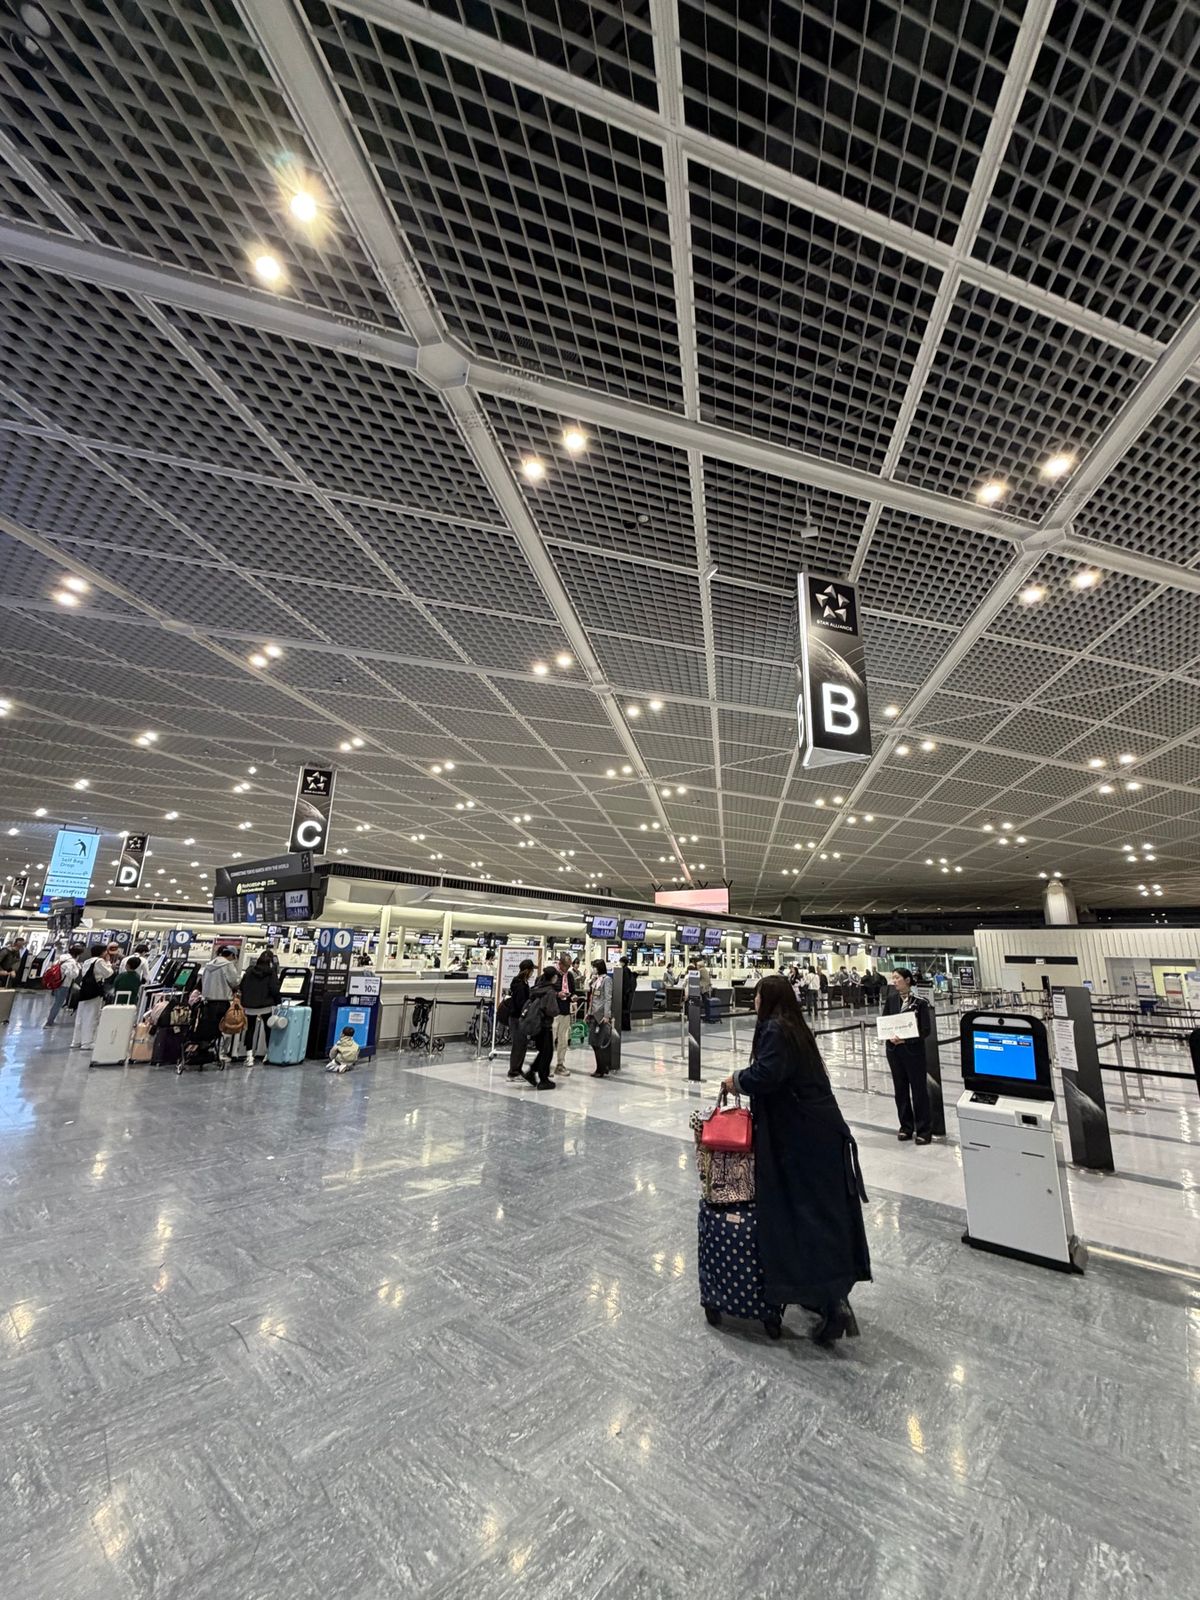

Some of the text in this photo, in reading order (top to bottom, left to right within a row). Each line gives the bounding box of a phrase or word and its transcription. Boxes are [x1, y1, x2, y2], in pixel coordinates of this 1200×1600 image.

[816, 619, 853, 632] STAR ALLIANCE
[822, 682, 859, 736] B
[297, 820, 322, 848] C
[119, 866, 138, 884] D
[10, 895, 22, 907] F
